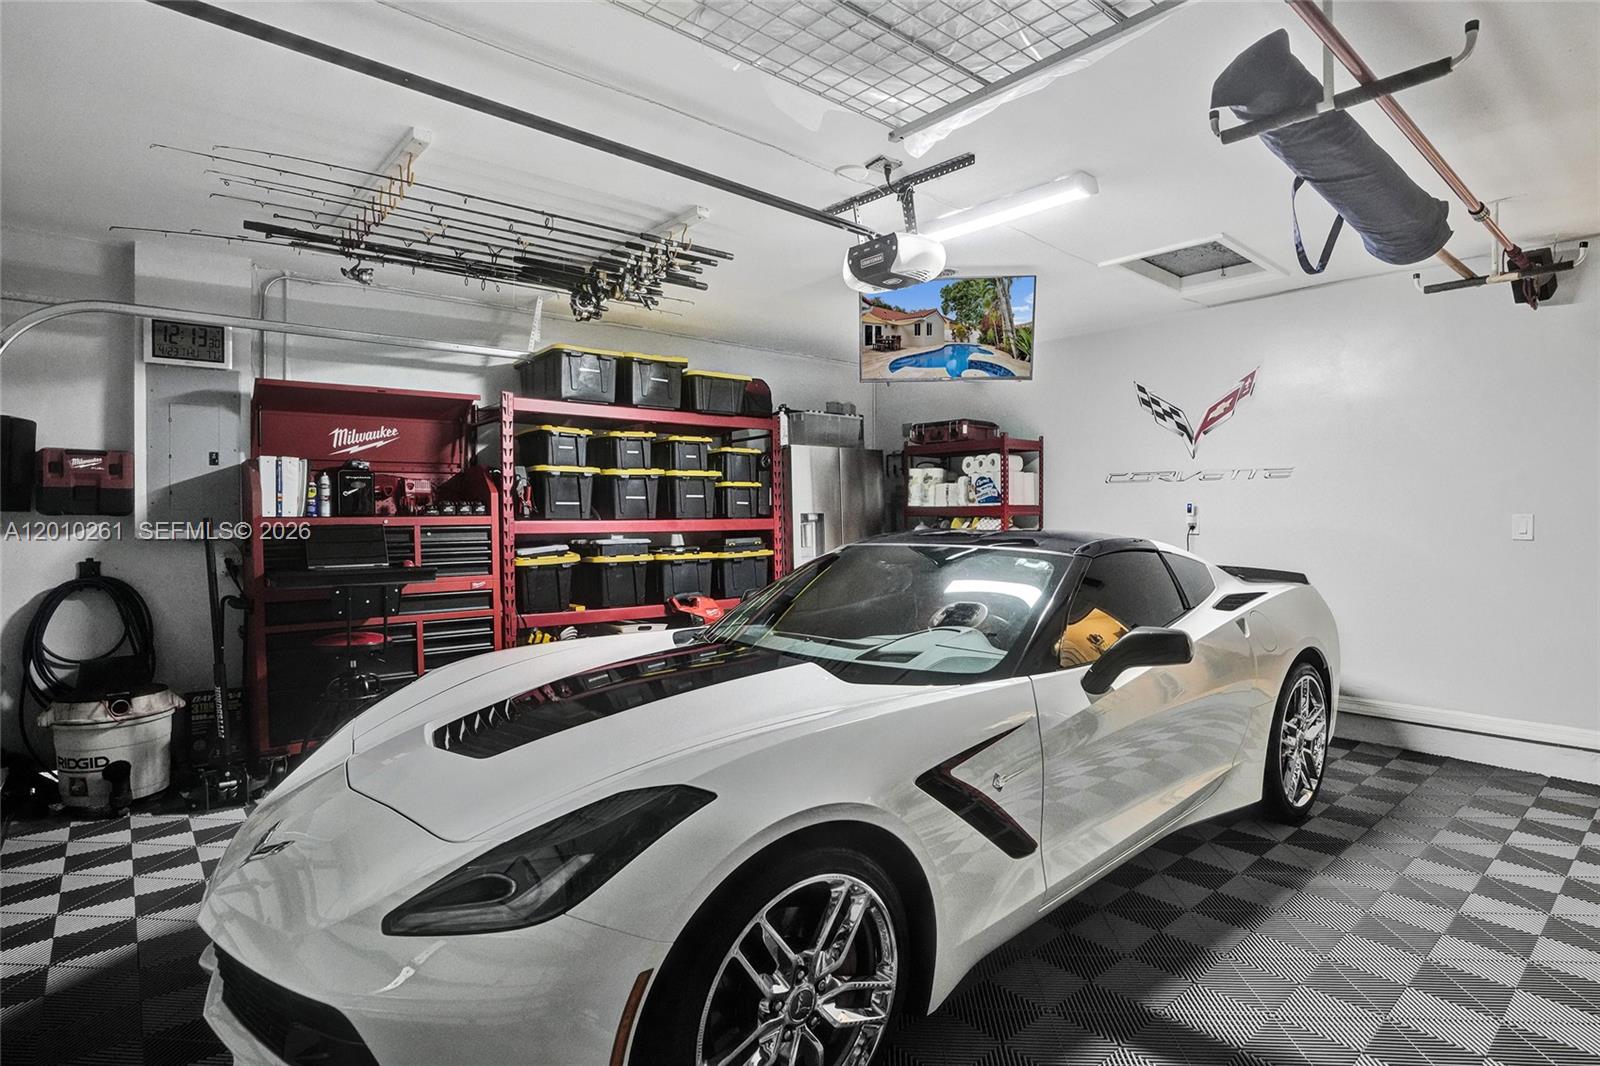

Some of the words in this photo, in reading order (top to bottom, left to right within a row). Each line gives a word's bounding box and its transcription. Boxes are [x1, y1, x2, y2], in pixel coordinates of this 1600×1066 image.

[163, 324, 207, 347] 12:13
[328, 425, 399, 449] Milwaukee
[58, 756, 110, 769] RIDGID
